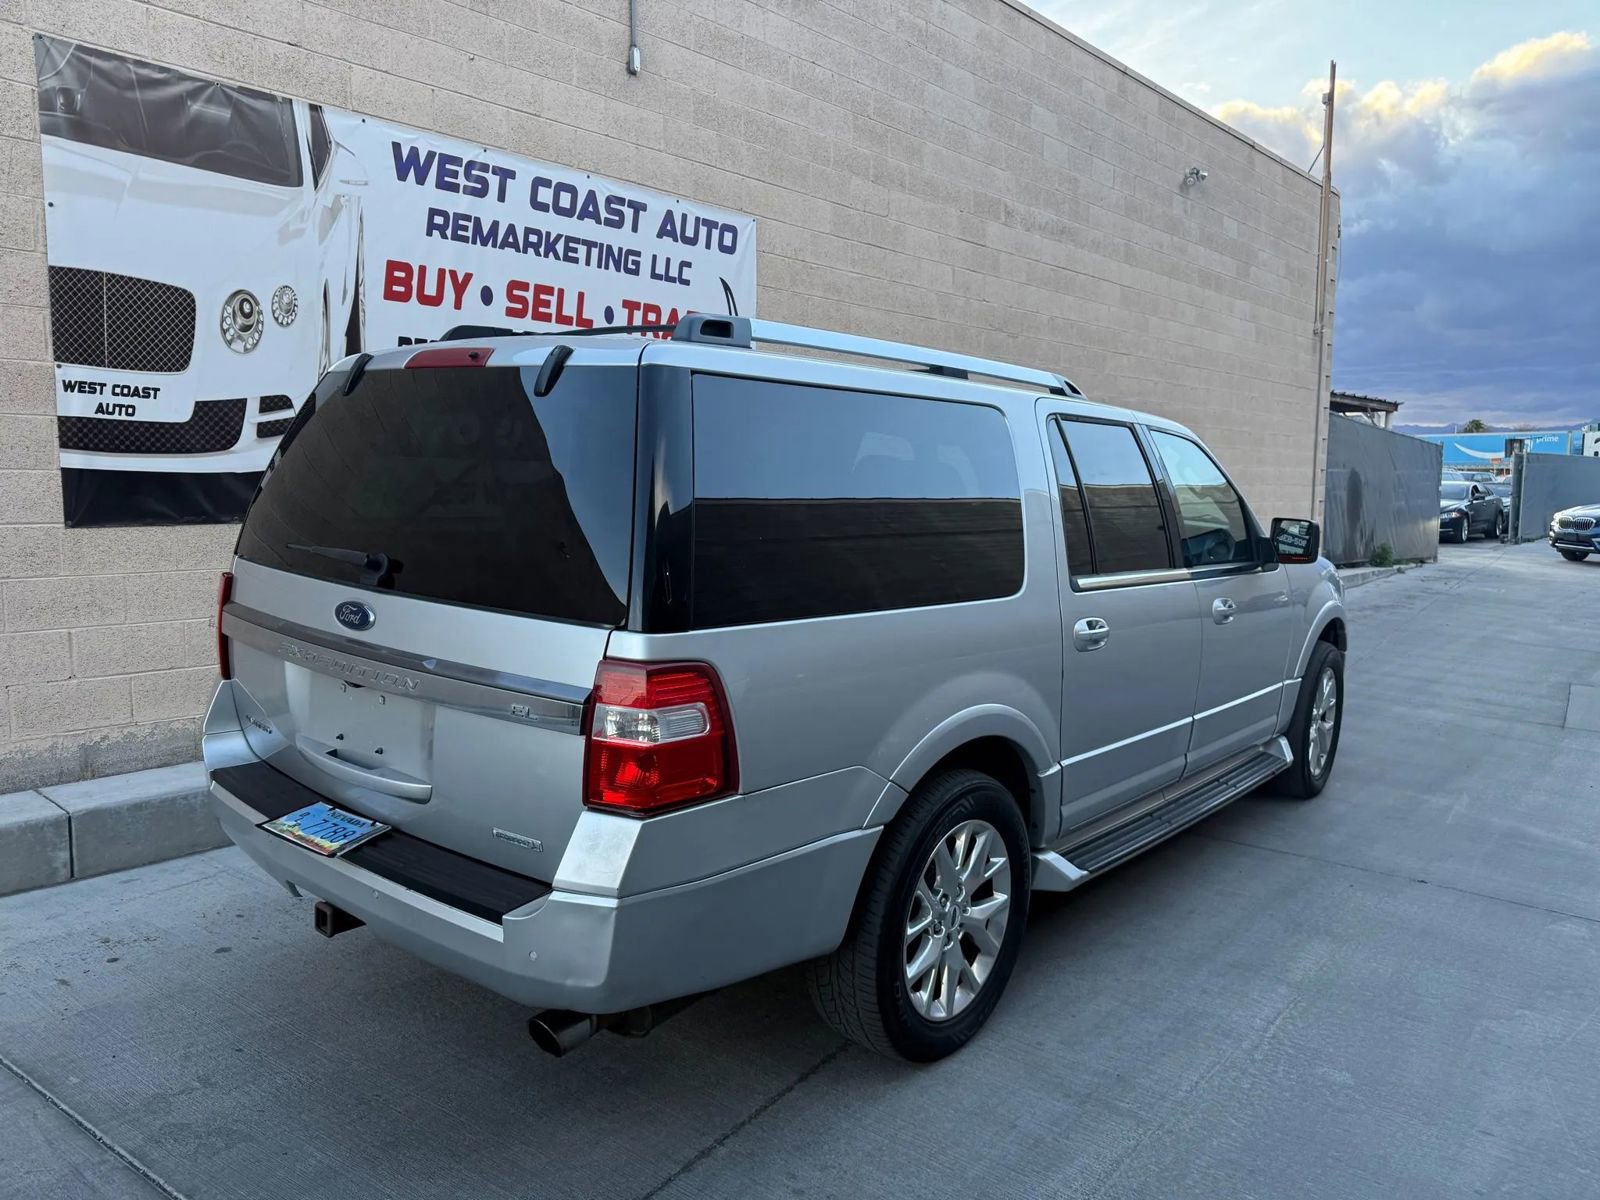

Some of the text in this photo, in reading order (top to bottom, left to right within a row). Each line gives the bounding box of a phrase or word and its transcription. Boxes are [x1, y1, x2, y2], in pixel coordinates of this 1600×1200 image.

[391, 141, 738, 255] WEST COAST AUTO
[425, 207, 693, 286] REMARKETING LLC
[383, 259, 473, 311] BUY
[505, 280, 594, 328] SELL
[62, 379, 160, 399] WEST COAST
[94, 402, 136, 417] AUTO
[340, 604, 362, 625] Ford
[302, 819, 356, 843] 7788
